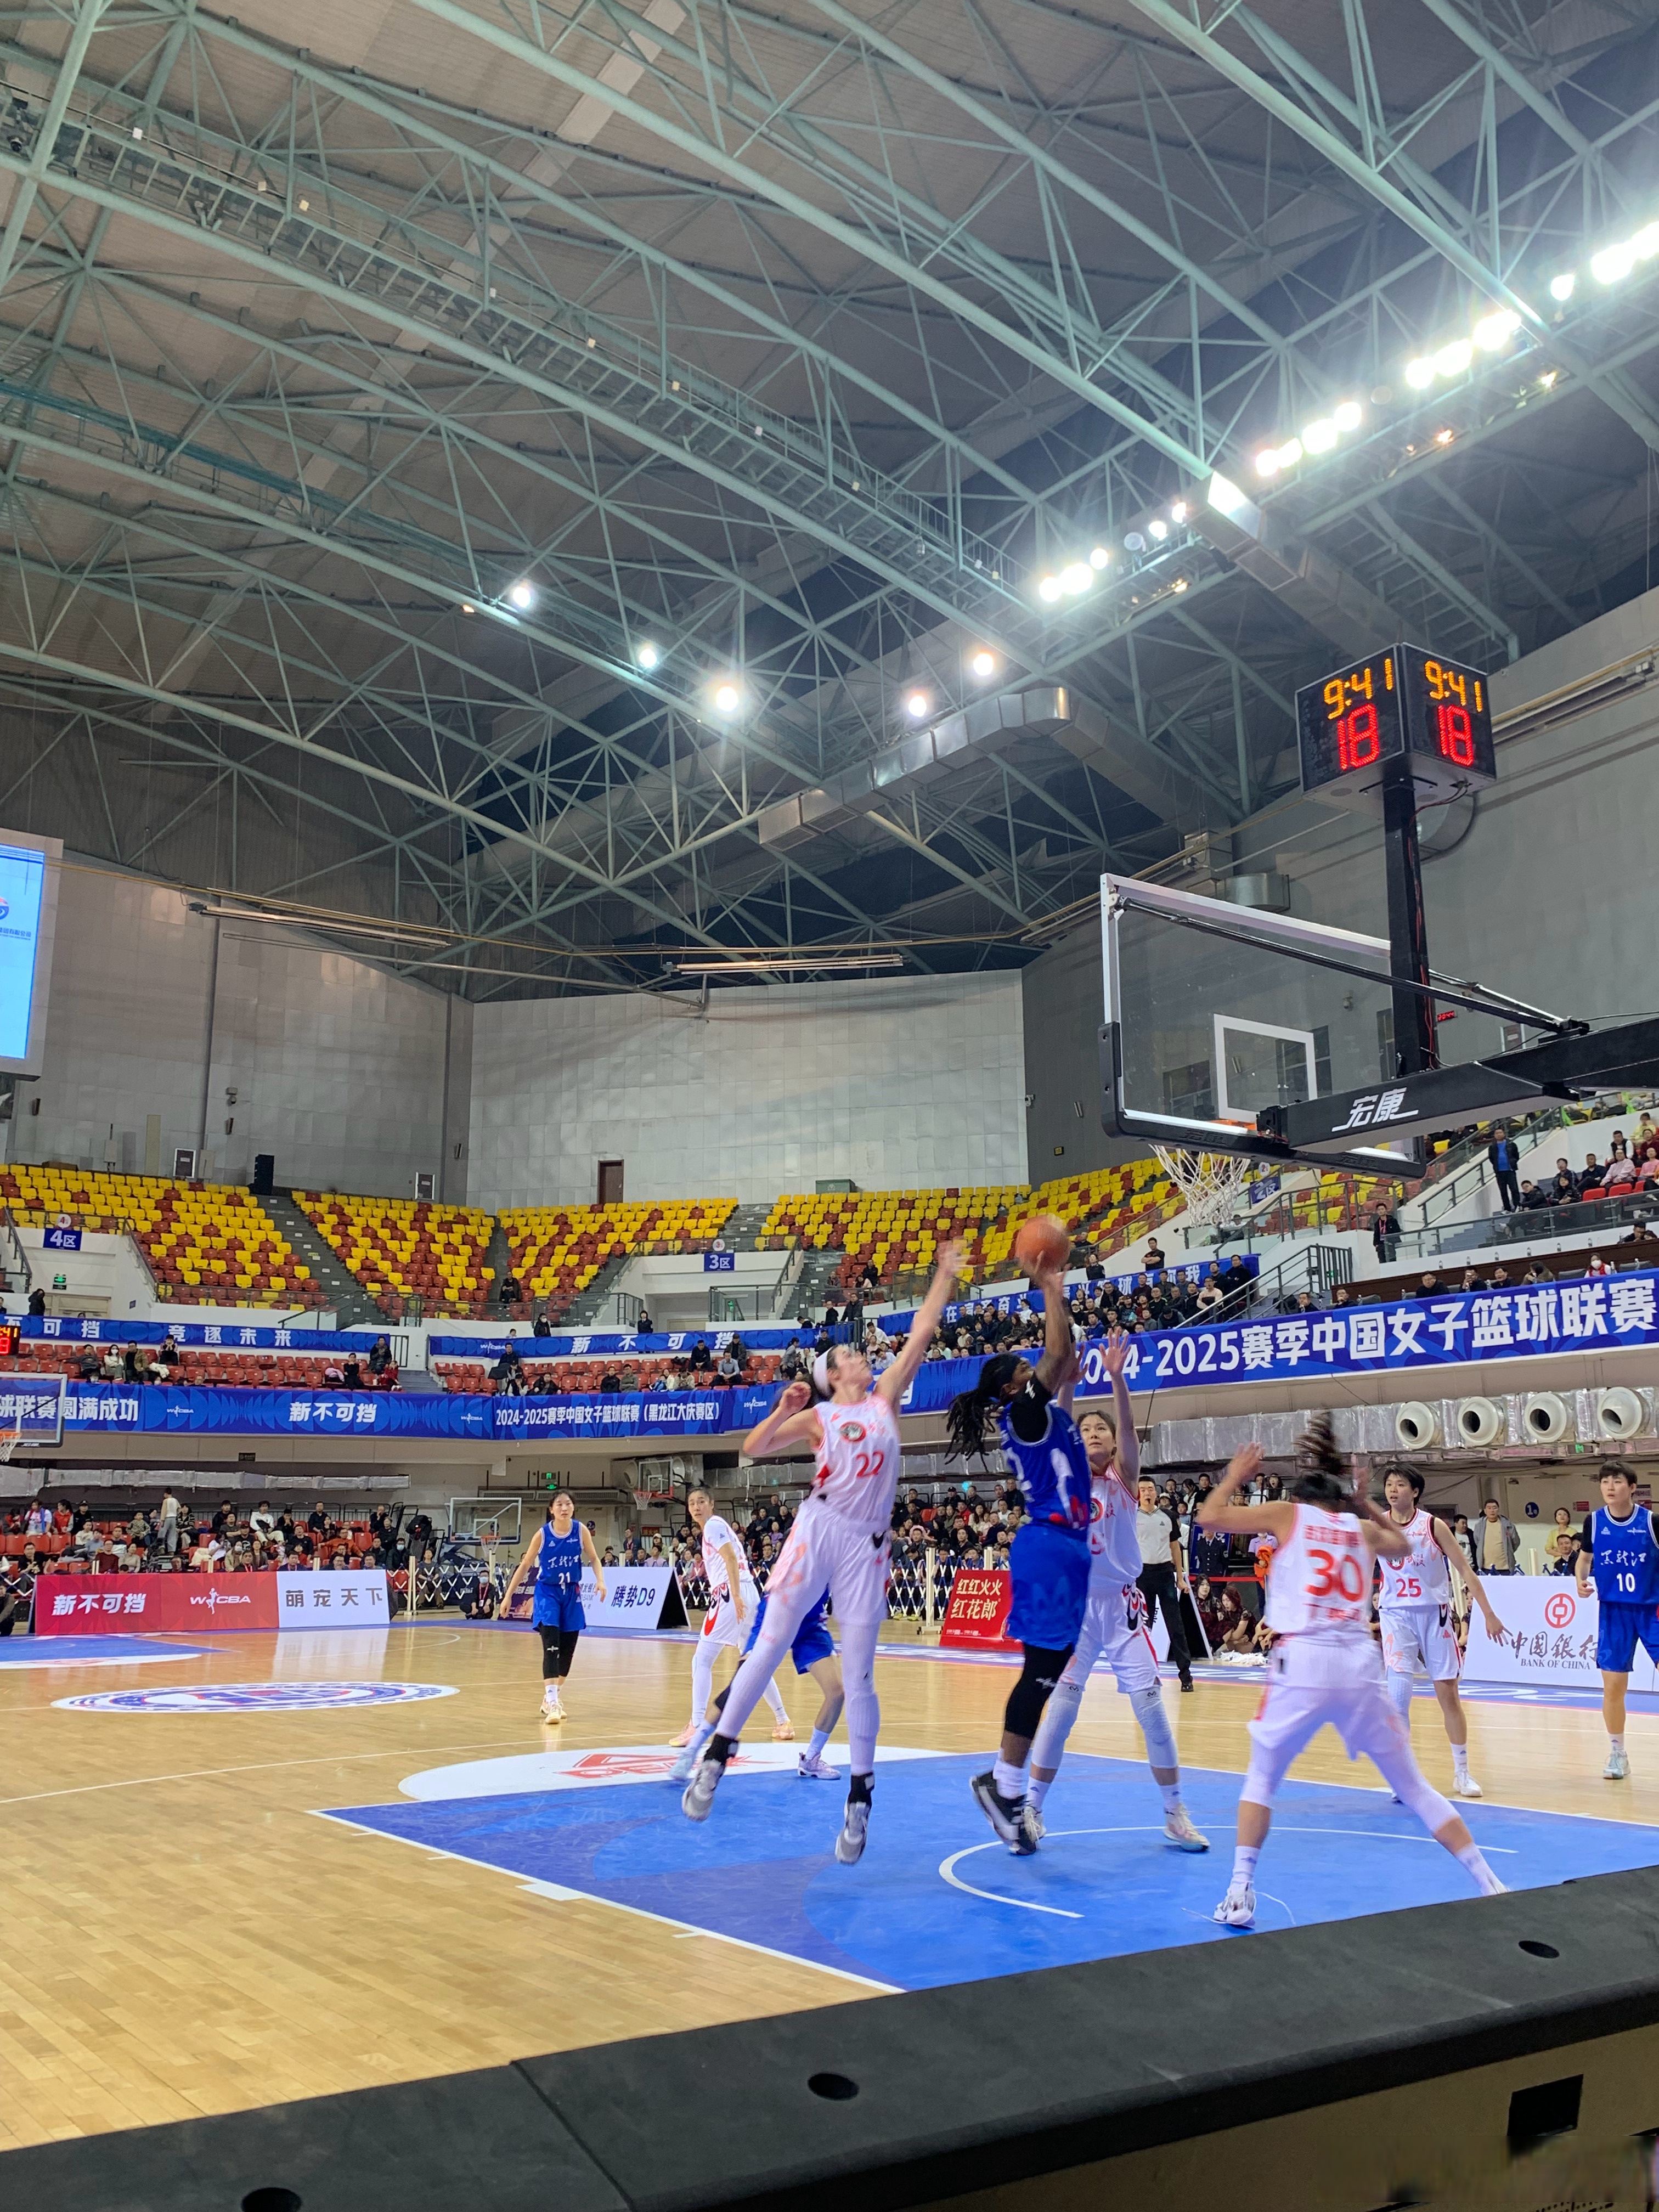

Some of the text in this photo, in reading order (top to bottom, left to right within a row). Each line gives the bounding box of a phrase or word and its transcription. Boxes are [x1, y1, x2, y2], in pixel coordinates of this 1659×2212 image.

[1324, 658, 1393, 720] 9:41
[1425, 661, 1482, 712] 9:41
[1338, 704, 1380, 770] 18
[1438, 704, 1474, 766] 18
[50, 1230, 76, 1248] 4区
[709, 1254, 730, 1269] 3区
[168, 1324, 291, 1347] 竞逐未来
[570, 1332, 734, 1355] 新不可挡
[289, 1401, 377, 1423] 新不可挡
[856, 1451, 884, 1477] 22
[558, 1572, 571, 1584] 21
[956, 1578, 1003, 1595] 红红火火
[1305, 1549, 1364, 1602] 30
[1616, 1573, 1635, 1592] 10
[286, 1587, 383, 1608] 萌宠天下
[611, 1585, 656, 1608] 腾势D9
[1396, 1578, 1421, 1598] 25
[52, 1593, 146, 1616] 新不可挡
[190, 1593, 251, 1607] WCBA
[950, 1598, 998, 1621] 红花郎
[1520, 1659, 1545, 1667] BANK
[1561, 1662, 1590, 1670] CHINA
